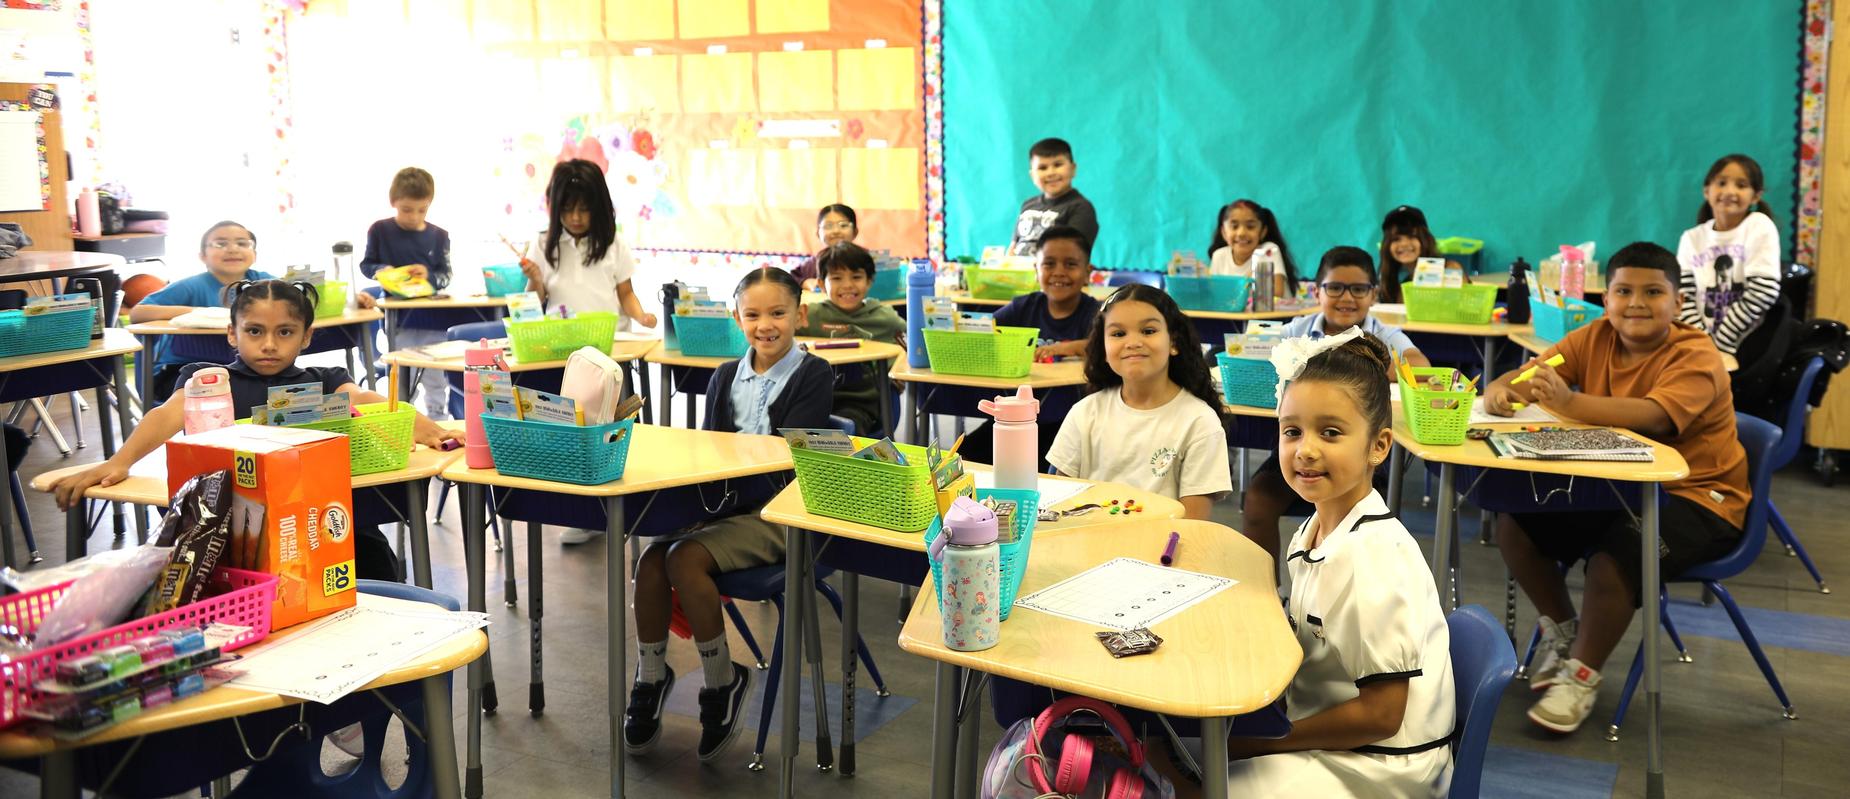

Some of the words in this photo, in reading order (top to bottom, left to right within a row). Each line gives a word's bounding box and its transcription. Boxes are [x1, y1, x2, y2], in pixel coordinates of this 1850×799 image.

[236, 456, 255, 474] 20
[238, 476, 255, 486] PACKS
[308, 506, 320, 551] CHEDDAR
[328, 509, 342, 540] Goldfish
[279, 537, 288, 565] CHEESE
[288, 537, 298, 561] REAL
[335, 563, 349, 589] 20
